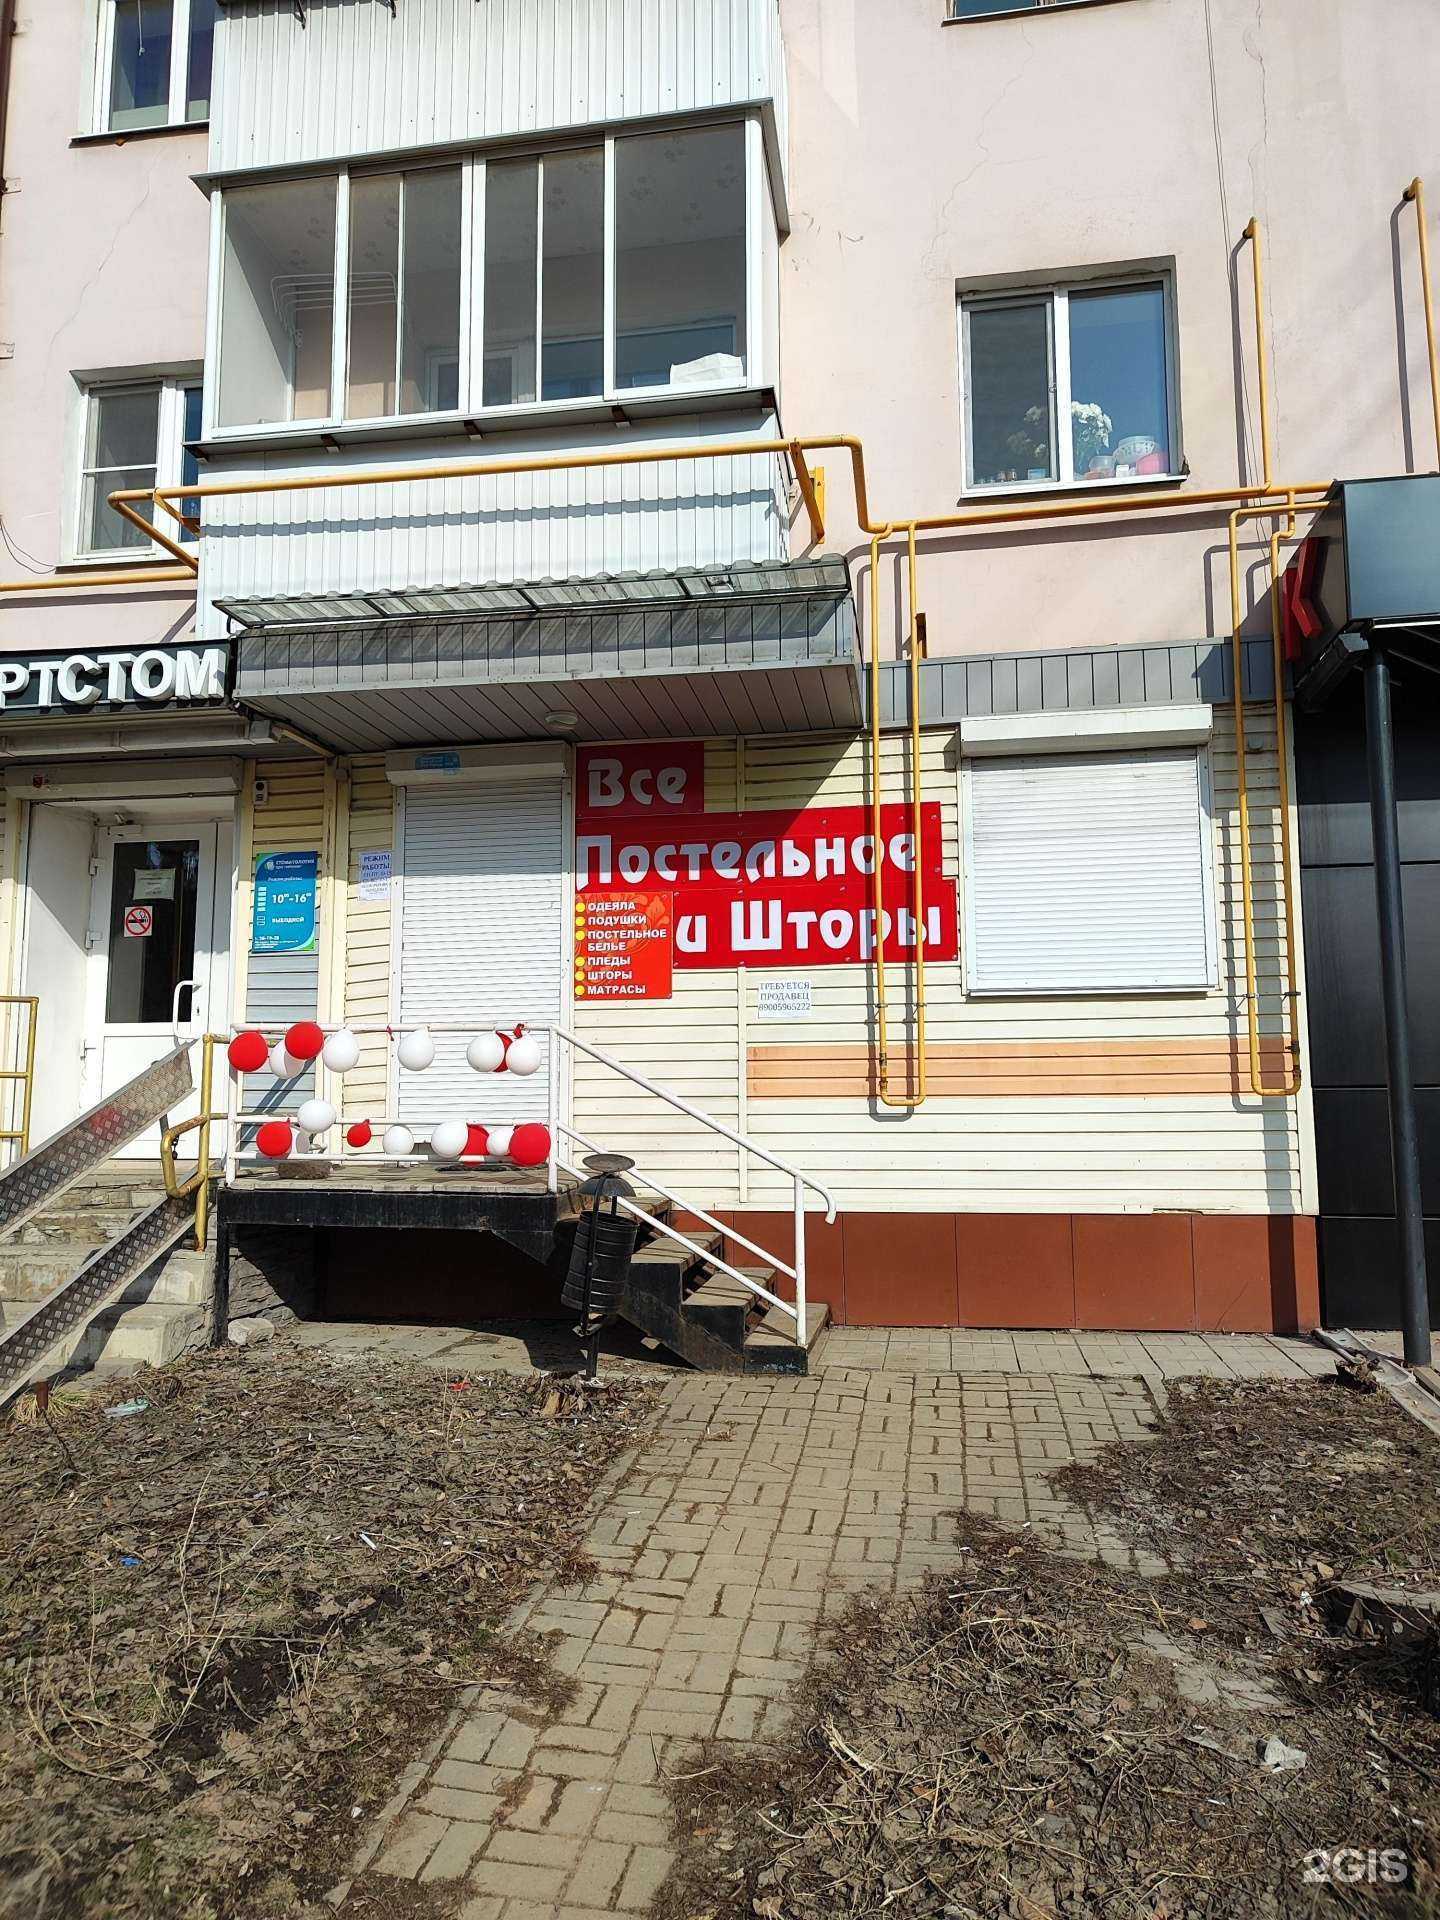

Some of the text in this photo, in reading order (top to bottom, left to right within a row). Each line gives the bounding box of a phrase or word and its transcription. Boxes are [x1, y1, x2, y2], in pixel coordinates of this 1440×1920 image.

[0, 649, 226, 709] РТСТОМ
[588, 758, 686, 808] Все
[576, 833, 917, 891] Постельное
[587, 901, 636, 912] ОДЕЯЛА
[587, 915, 647, 926] ПОДУШКИ
[587, 929, 667, 940] ПОСТЕЛЬНОЕ
[675, 898, 941, 960] и Шторы
[587, 941, 627, 952] БЕЛЬЕ
[587, 956, 631, 966] ПЛЕДЫ
[587, 970, 633, 980] ШТОРЫ
[587, 984, 646, 995] МАТРАСЫ
[760, 981, 810, 990] ТРЕБУЕТСЯ
[760, 992, 810, 1001] ПРОДАВЕЦ
